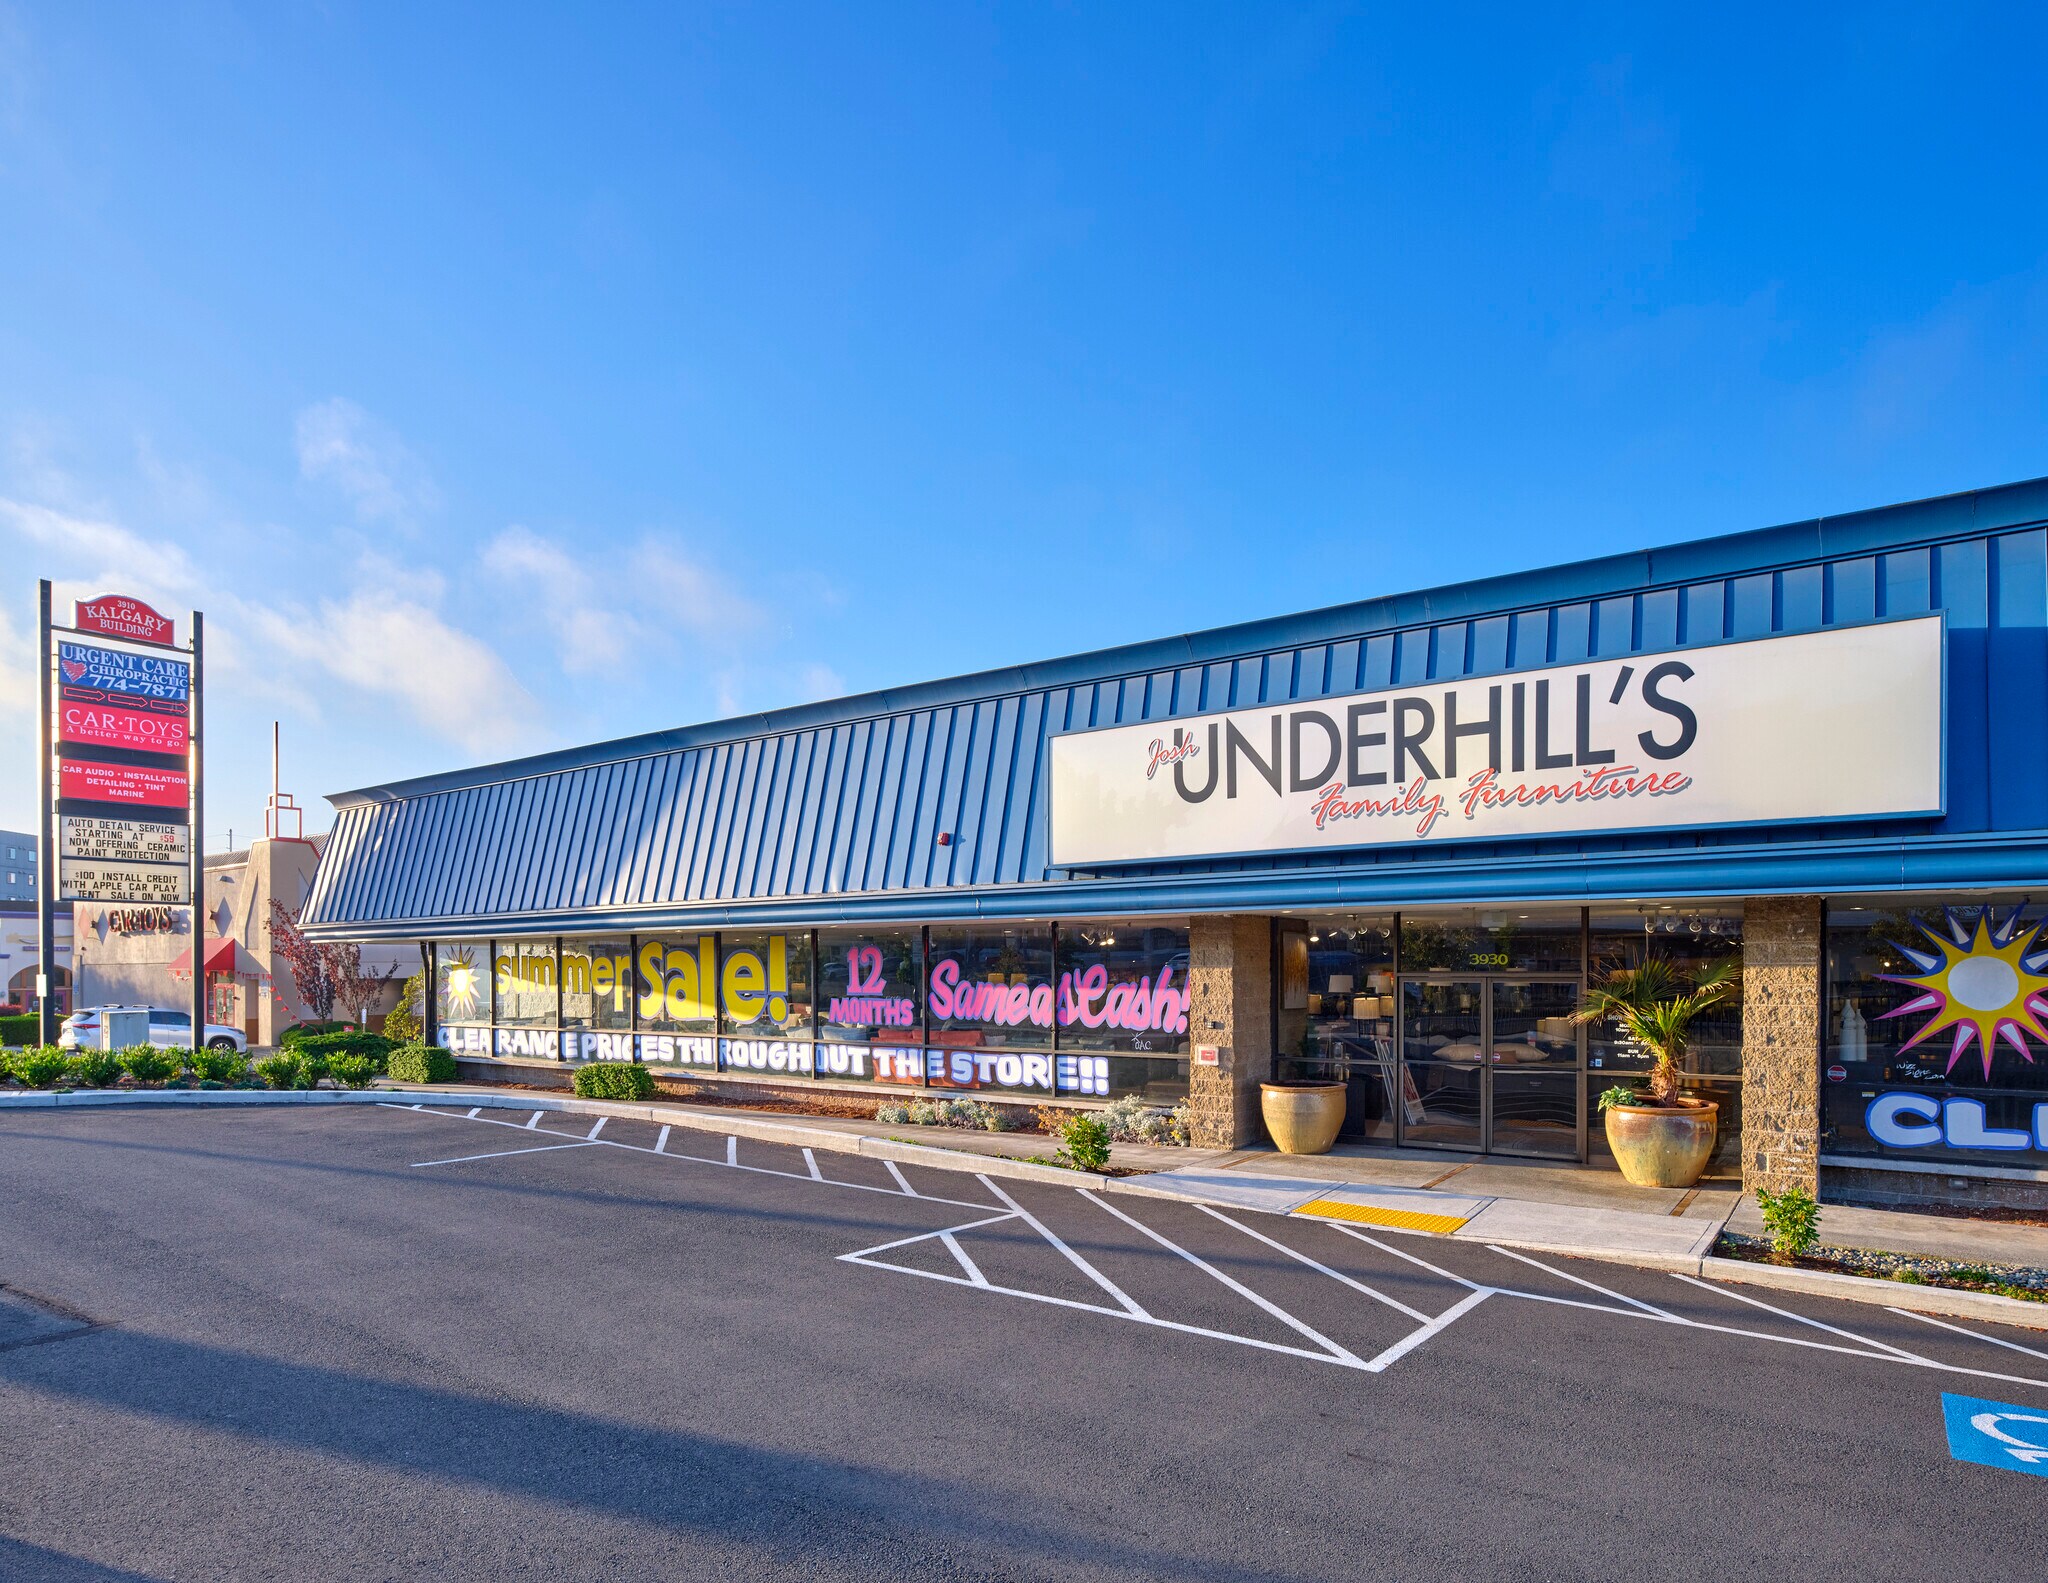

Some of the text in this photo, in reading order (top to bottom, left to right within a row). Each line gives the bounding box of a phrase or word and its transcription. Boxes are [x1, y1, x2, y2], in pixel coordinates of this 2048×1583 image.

[117, 600, 136, 610] 3910
[85, 605, 167, 632] KALGARY
[100, 619, 153, 637] BUILDING
[60, 643, 188, 678] URGENT CARE
[89, 663, 188, 687] CHIROPRACTIC
[89, 674, 188, 700] 774-7871
[66, 725, 184, 748] A better way to go.
[1147, 660, 1698, 802] Josh UNDERHILL'S
[62, 765, 187, 785] CAR AUDIO INSTALLATION
[86, 778, 166, 791] DETAILING TINT
[108, 789, 145, 798] MARINE
[1310, 764, 1695, 837] Family Furniture
[68, 818, 175, 834] AUTO DETAIL SERVICE
[75, 829, 175, 843] STARTING AT $59
[69, 837, 186, 853] NOW OFFERING CERAMIC
[77, 848, 170, 861] PAINT PROTECTION
[61, 880, 178, 893] WITH APPLE CAR PLAY
[75, 871, 178, 884] $100 INSTALL CREDIT
[78, 890, 180, 902] TENT SALE ON NOW
[1469, 953, 1508, 965] 3930
[495, 932, 788, 1025] summer Sale!
[847, 945, 887, 996] 12
[928, 959, 1030, 1026] Same
[1030, 972, 1080, 1028] as
[829, 997, 915, 1026] MONTHS
[437, 1026, 578, 1060] CLEARANCE
[581, 1033, 675, 1063] PRICES
[872, 1047, 946, 1080] THE
[951, 1050, 1109, 1095] STORE!!
